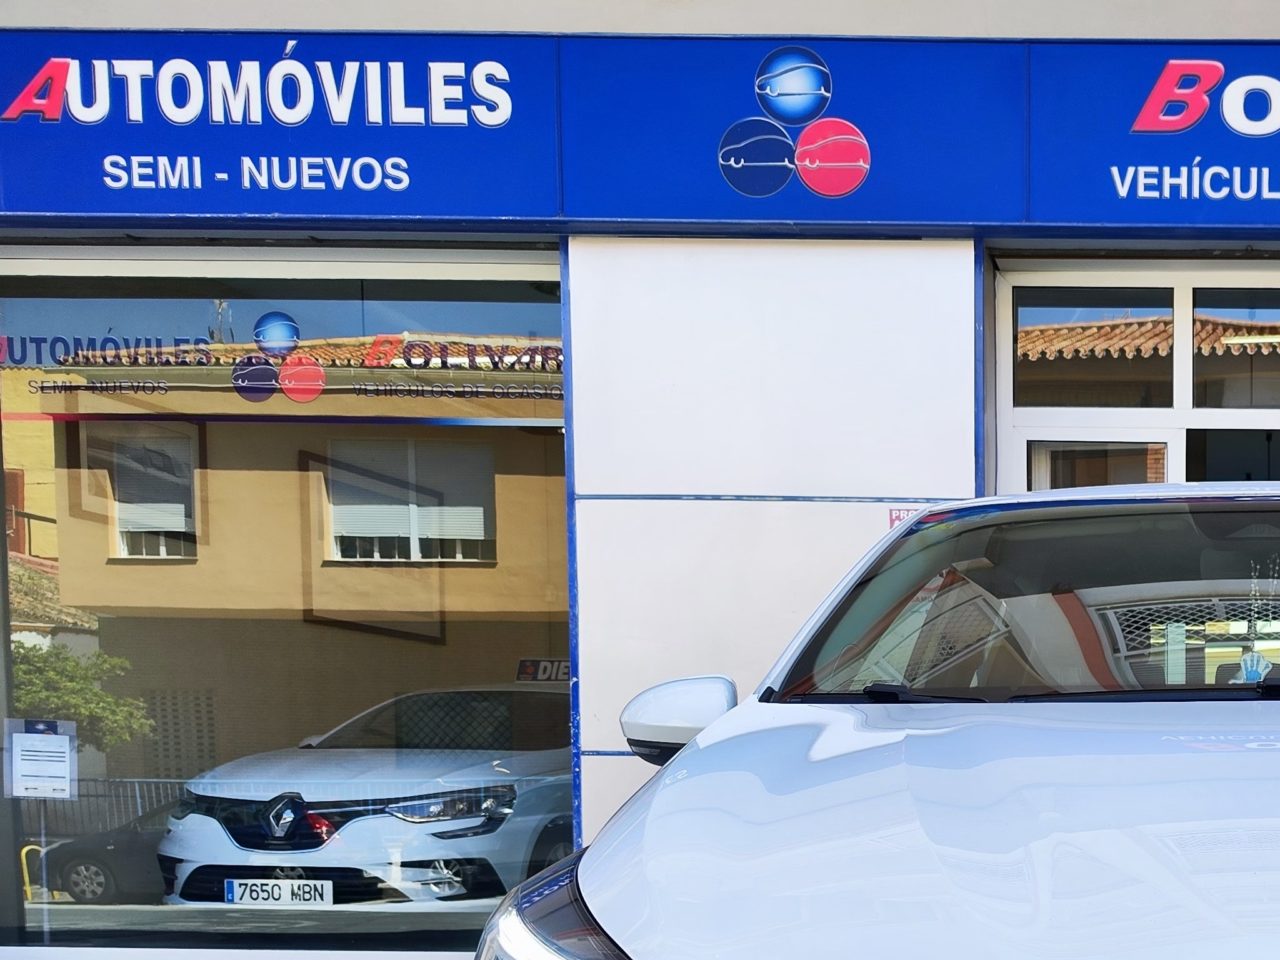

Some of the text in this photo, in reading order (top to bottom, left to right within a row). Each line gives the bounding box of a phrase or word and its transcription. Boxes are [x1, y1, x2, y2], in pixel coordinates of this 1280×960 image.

[0, 39, 513, 128] AUTOMÓVILES
[102, 155, 202, 189] SEMI
[241, 156, 410, 191] NUEVOS
[0, 327, 211, 366] UTOMÓVILES
[28, 379, 73, 395] SEMI
[91, 380, 169, 396] NUEVOS
[238, 883, 282, 901] 7650
[290, 883, 324, 902] MBN
